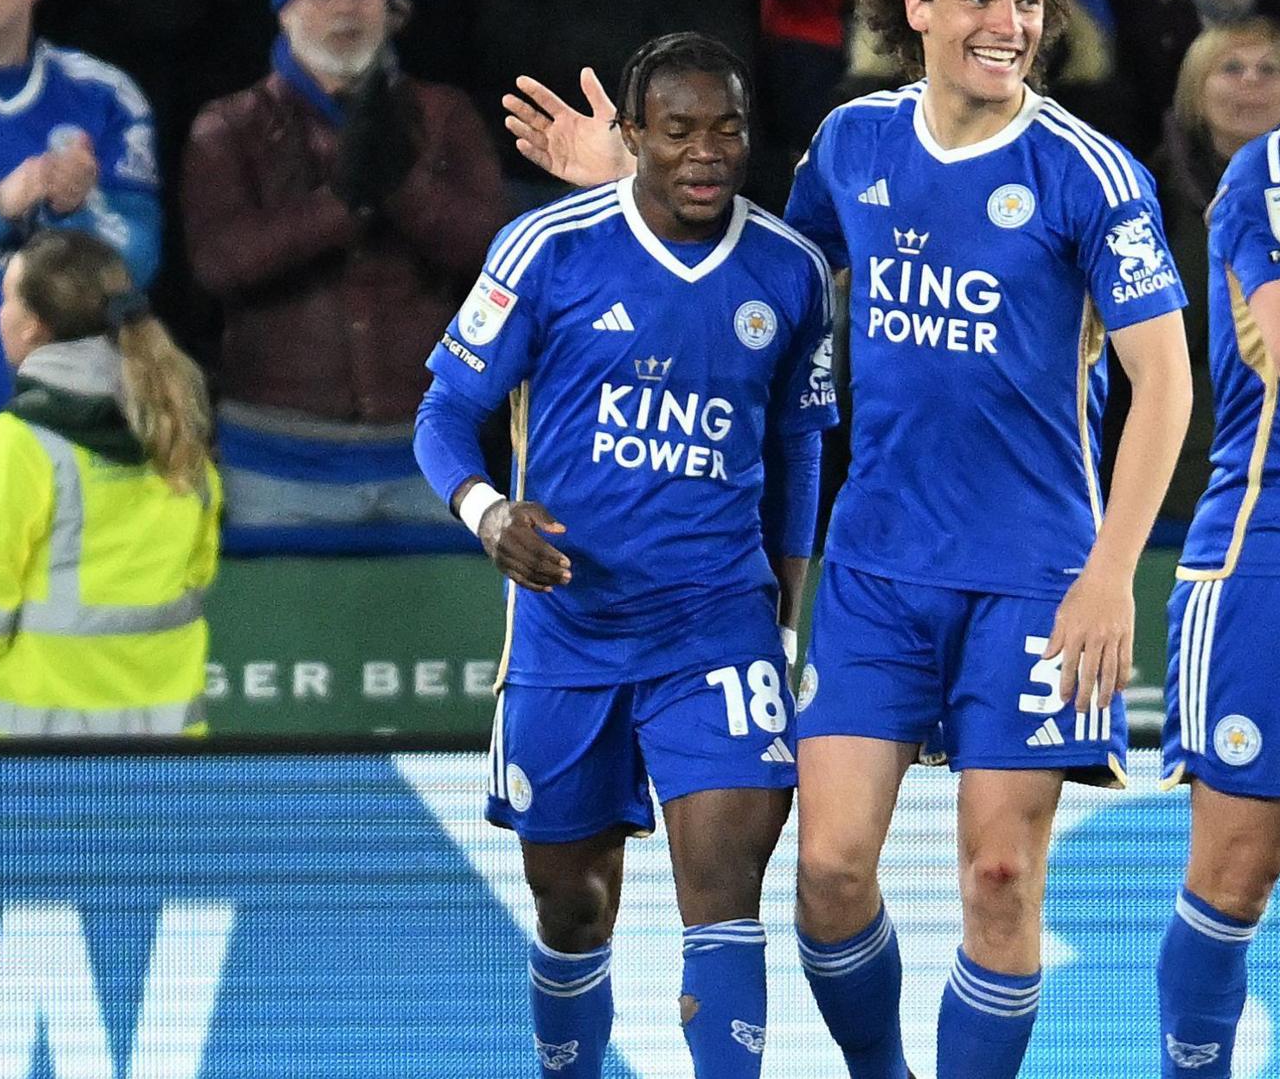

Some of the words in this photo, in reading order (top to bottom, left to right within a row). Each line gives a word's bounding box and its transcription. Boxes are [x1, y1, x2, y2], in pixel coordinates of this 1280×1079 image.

[869, 256, 1001, 314] KING
[1112, 269, 1178, 304] SAIGON
[868, 307, 998, 354] POWER
[597, 382, 734, 442] KING
[591, 431, 728, 481] POWER
[706, 660, 787, 736] 18
